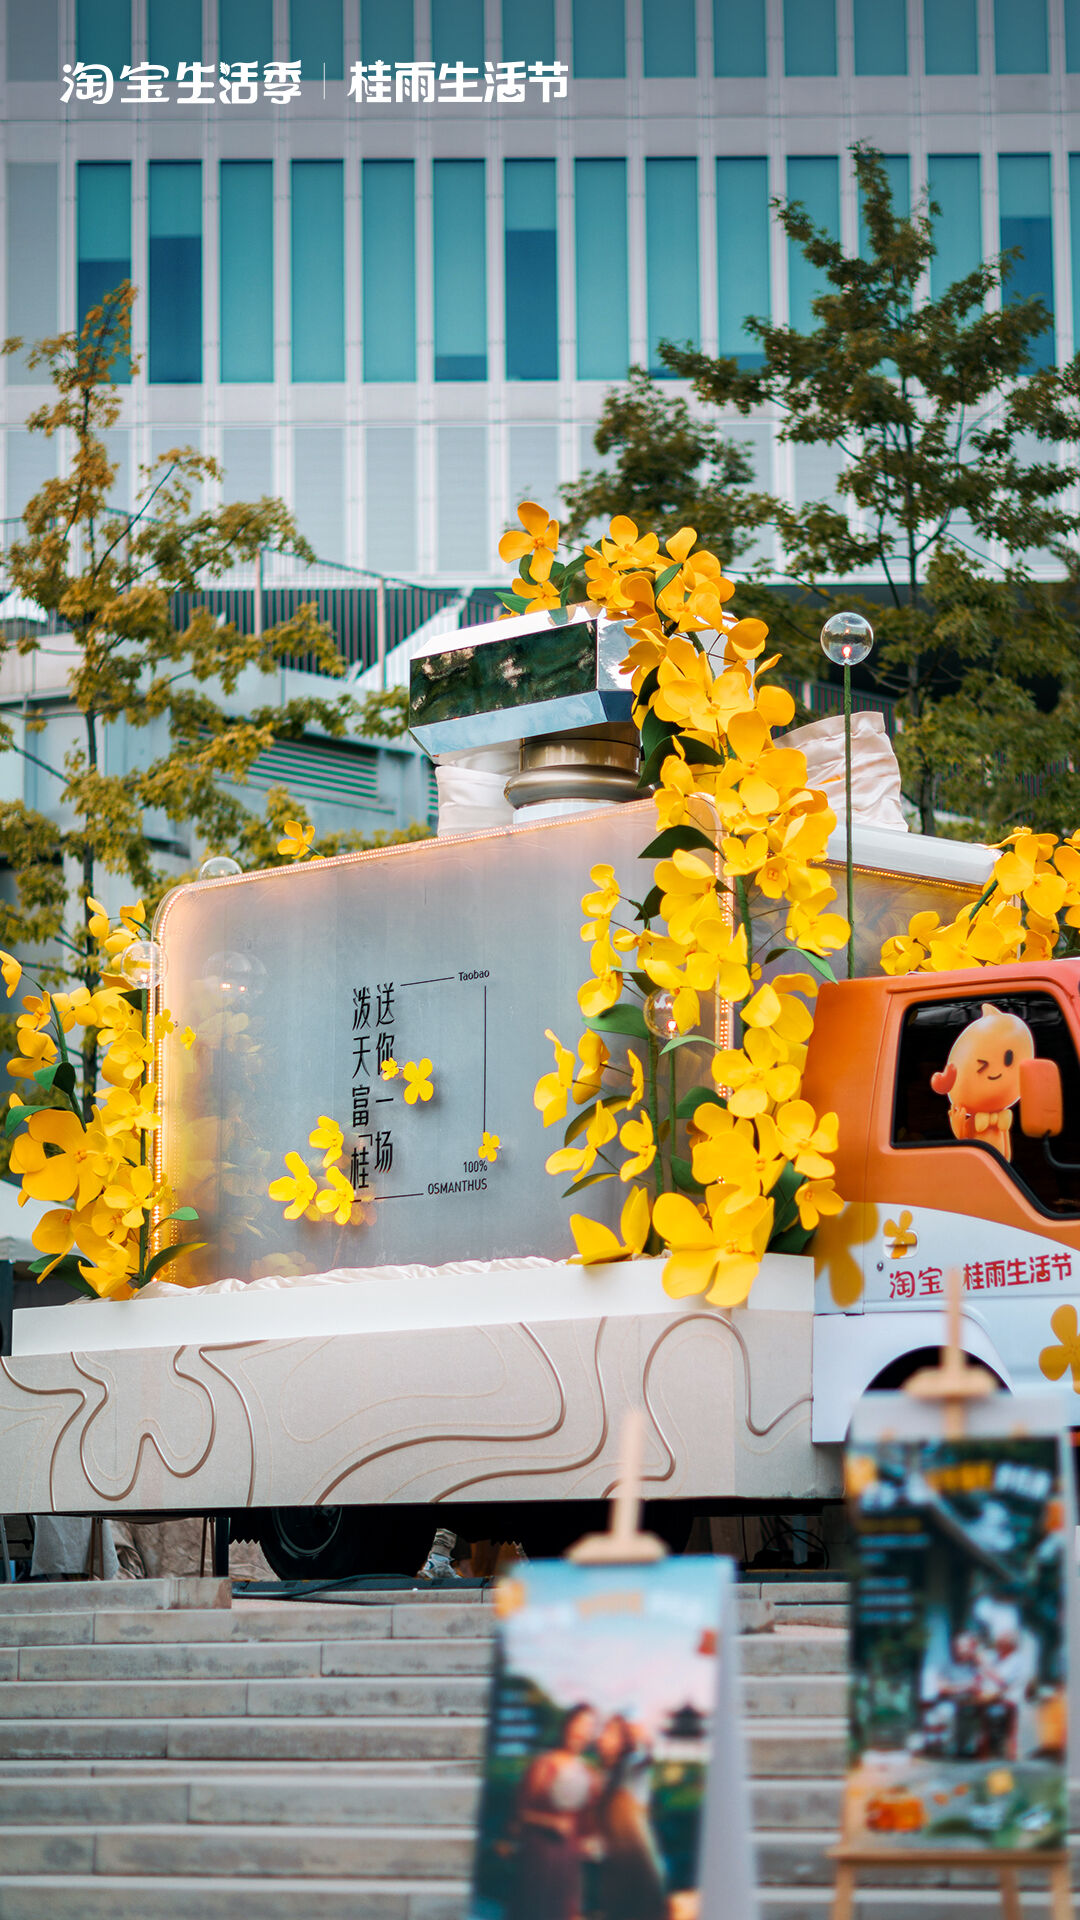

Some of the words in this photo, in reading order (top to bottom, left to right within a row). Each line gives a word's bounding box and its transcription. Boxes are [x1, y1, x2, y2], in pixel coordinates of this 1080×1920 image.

[458, 969, 490, 982] Taobao
[374, 982, 395, 1174] 送你一场
[463, 1160, 488, 1174] 100%
[428, 1178, 488, 1195] OSMANTHUS
[889, 1266, 944, 1299] 淘宝
[962, 1252, 1072, 1291] 桂雨生活节
